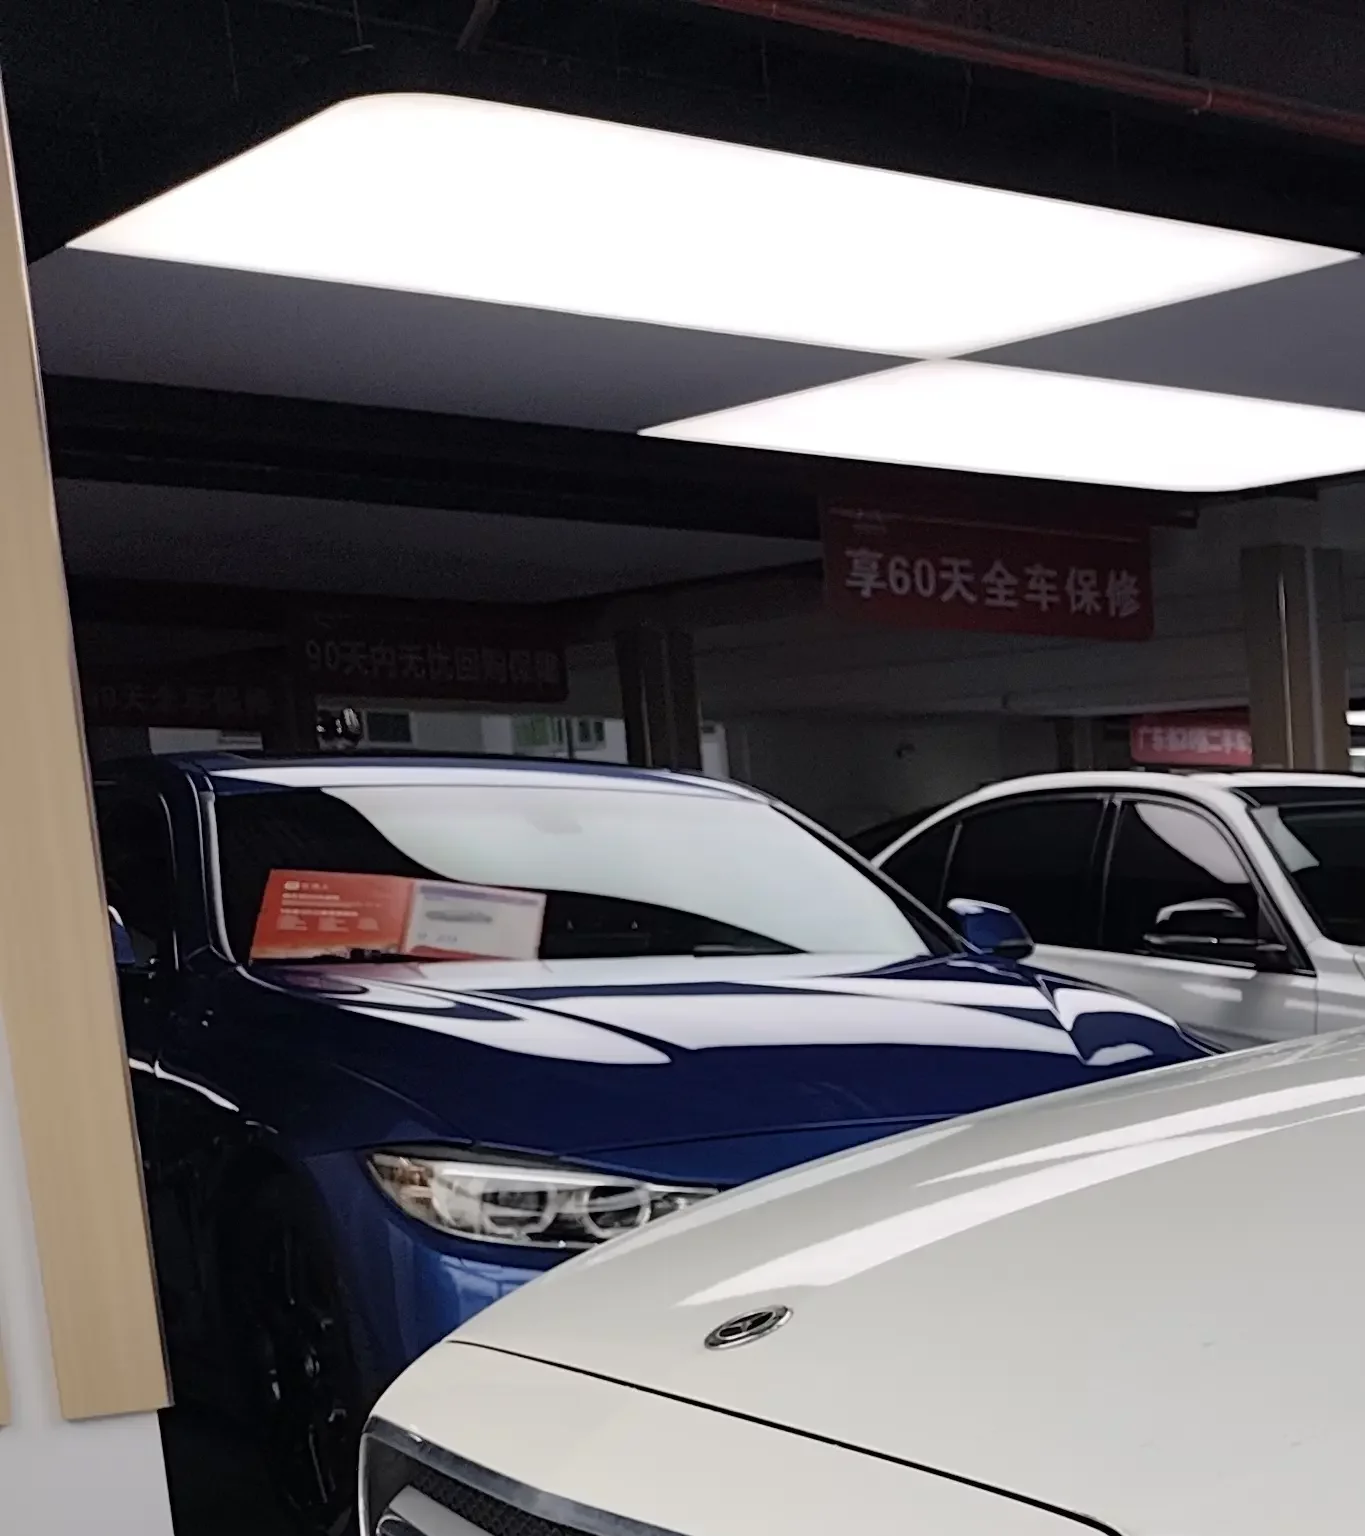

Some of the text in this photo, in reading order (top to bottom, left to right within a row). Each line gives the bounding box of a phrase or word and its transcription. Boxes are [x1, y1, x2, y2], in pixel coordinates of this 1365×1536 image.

[845, 547, 1141, 618] 享60天全车保修
